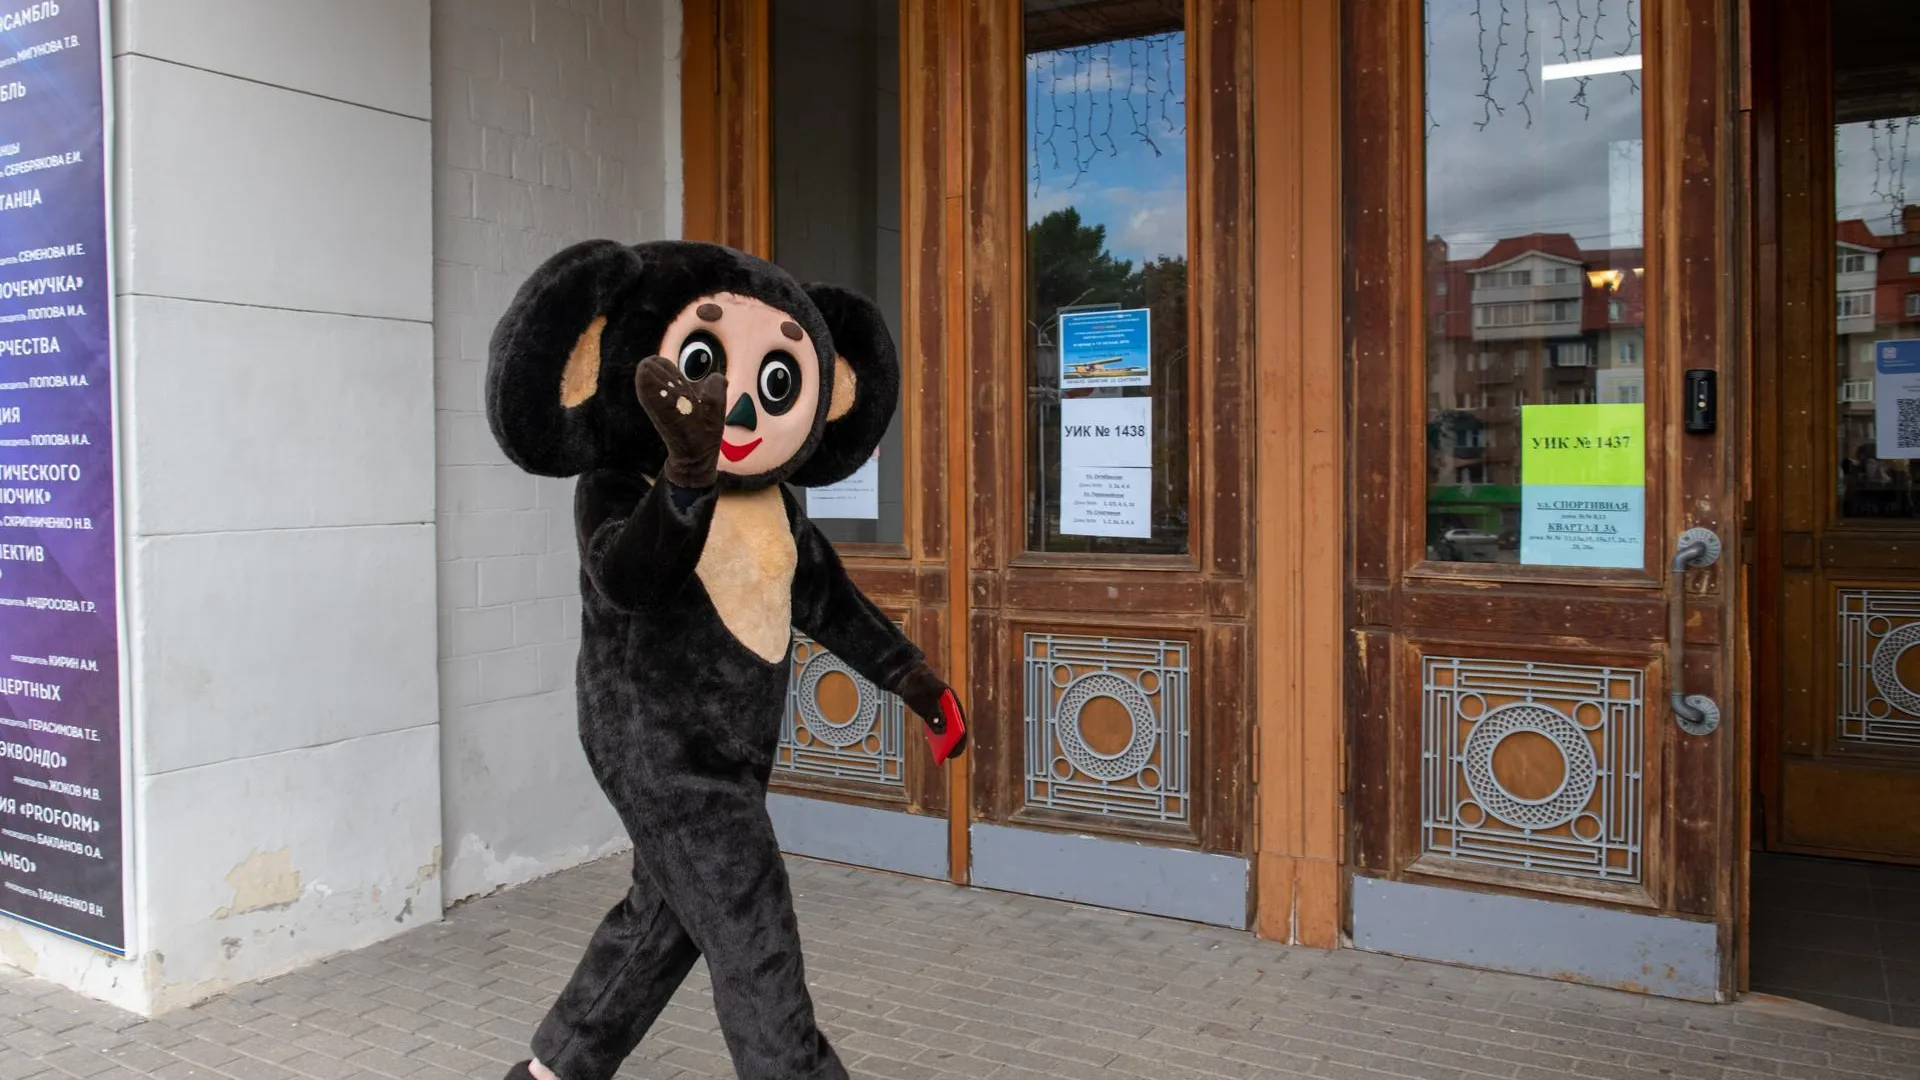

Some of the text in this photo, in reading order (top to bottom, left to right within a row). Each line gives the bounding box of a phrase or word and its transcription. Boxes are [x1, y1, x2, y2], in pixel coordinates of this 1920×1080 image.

[27, 306, 66, 320] ПОПОВА
[67, 304, 87, 317] И.А.
[29, 375, 69, 389] ПОПОВА
[70, 374, 89, 386] И.А.
[1064, 425, 1145, 437] УИК № 1438
[31, 434, 71, 446] ПОПОВА
[71, 433, 91, 445] И.А.
[1530, 436, 1630, 449] УИК № 1437
[74, 517, 94, 529] Н.В.
[0, 543, 44, 562] ЕКТИВ
[20, 802, 100, 833] «PROFORM»
[36, 833, 83, 854] БАКЛАНОВ
[84, 845, 104, 859] О.А.
[37, 888, 88, 912] ТАРАНЕНКО
